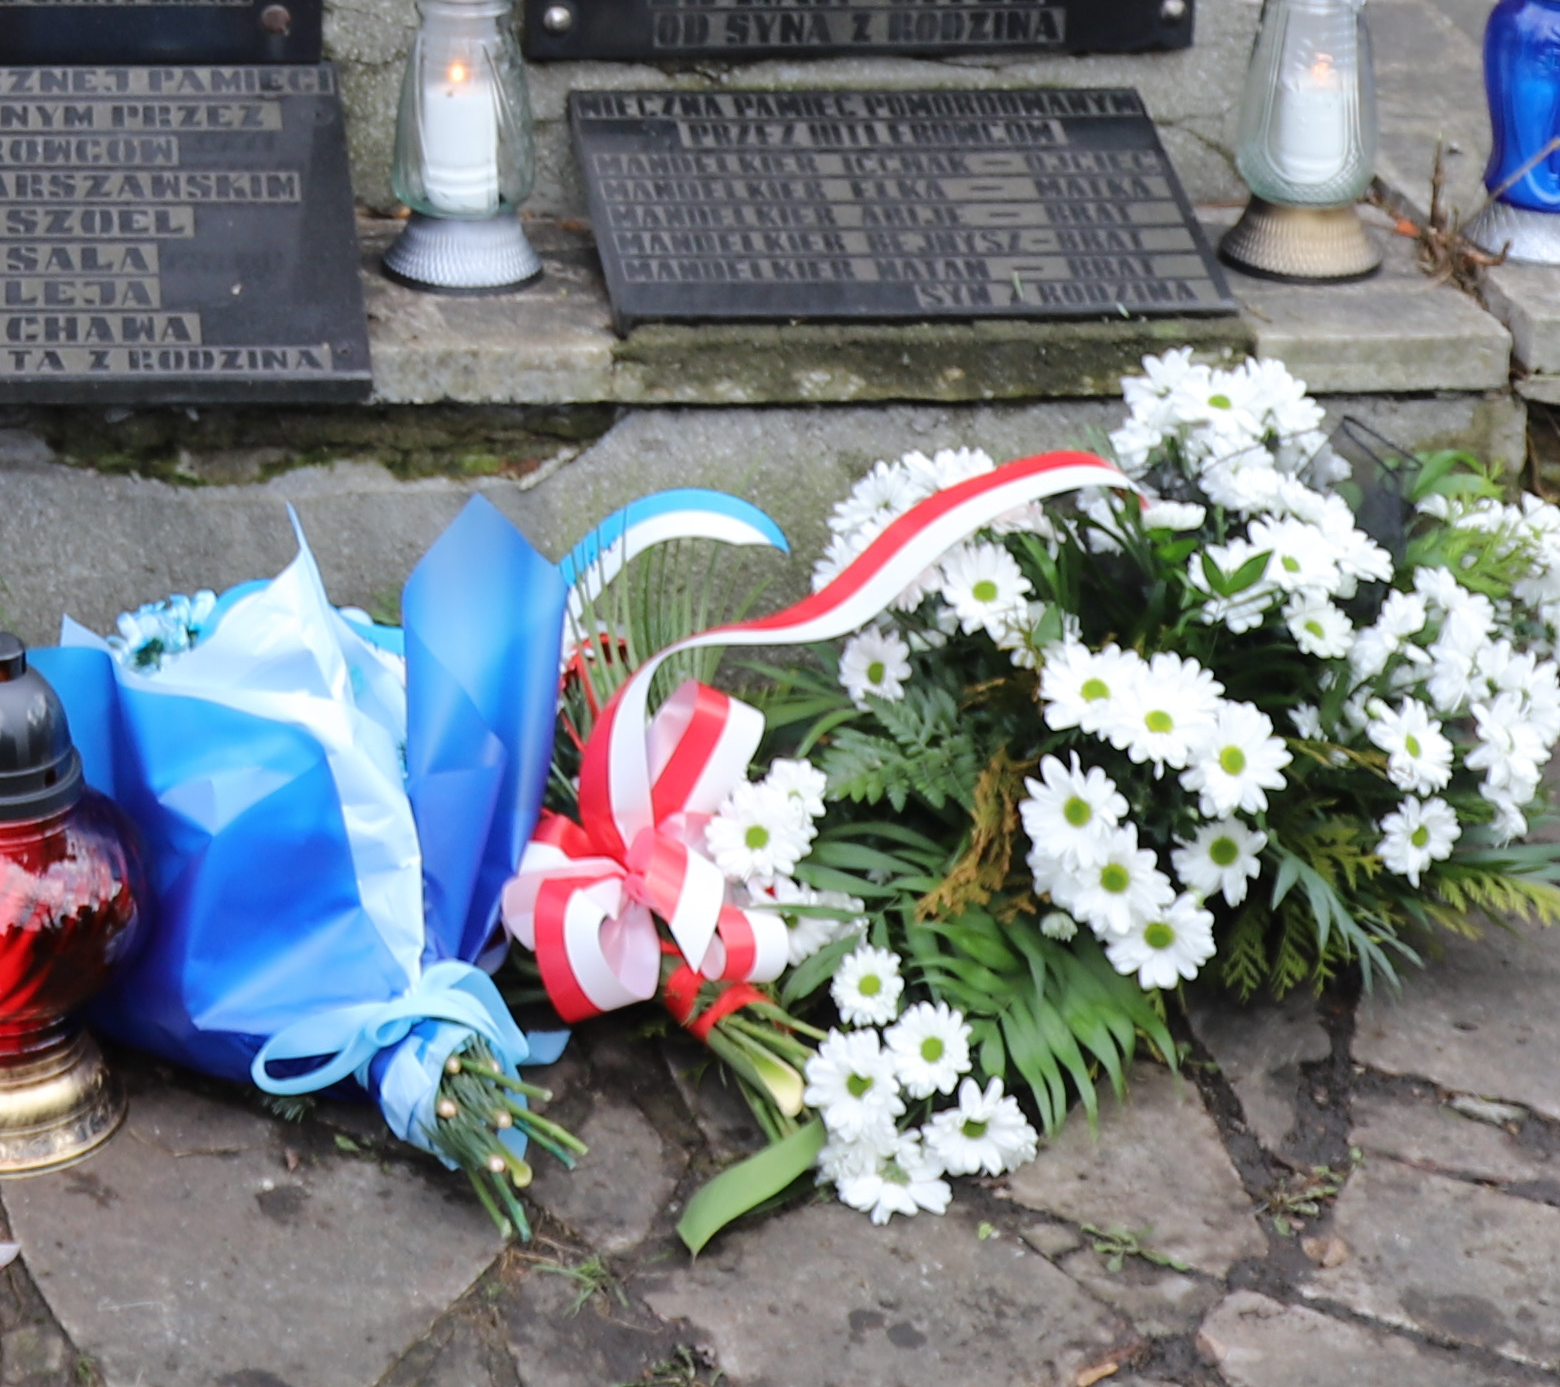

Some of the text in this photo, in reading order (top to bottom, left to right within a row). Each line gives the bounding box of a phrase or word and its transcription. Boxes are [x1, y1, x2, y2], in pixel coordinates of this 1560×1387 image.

[655, 13, 710, 46] OD
[724, 12, 833, 46] SYNA
[852, 13, 871, 43] Z
[109, 103, 266, 128] PRZEZ
[6, 208, 187, 235] SZOEL
[6, 245, 151, 272] SALA
[4, 280, 153, 307] LEJA
[917, 284, 982, 307] SYN
[5, 314, 194, 342] CHAWA
[88, 349, 112, 372] Z
